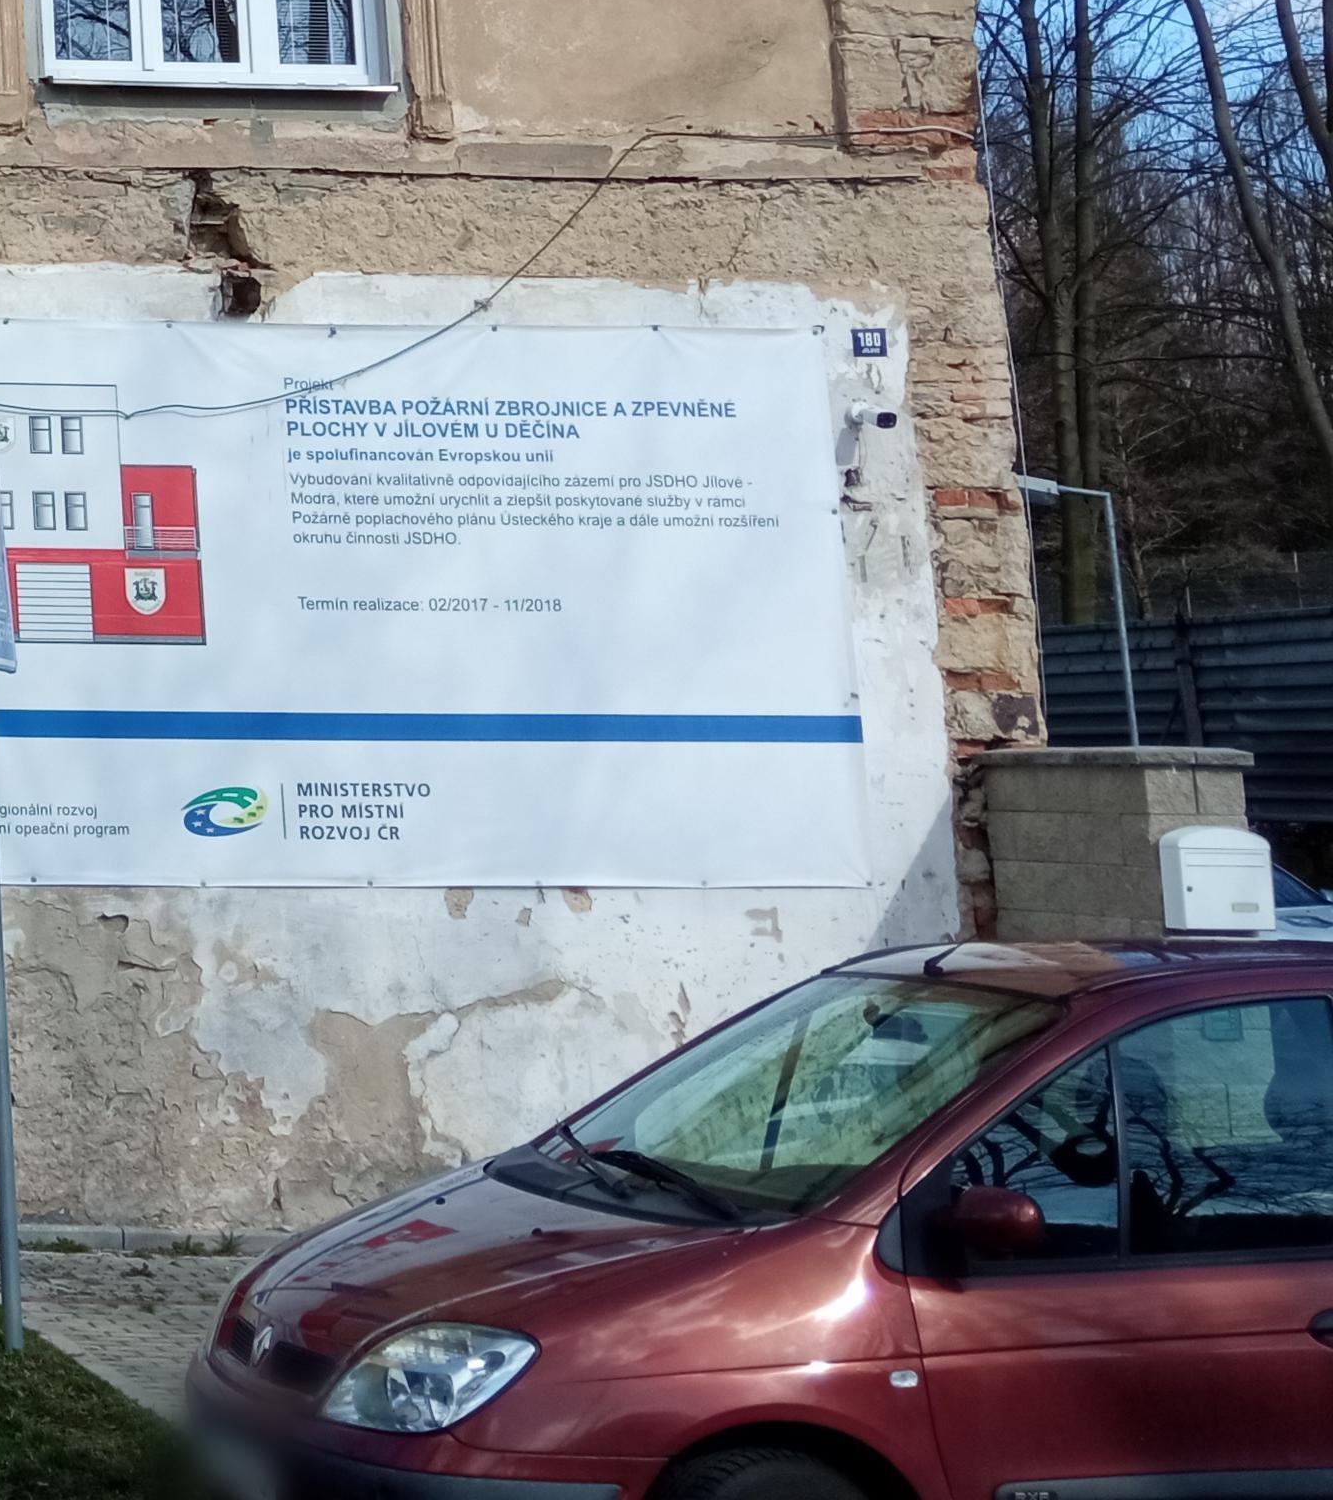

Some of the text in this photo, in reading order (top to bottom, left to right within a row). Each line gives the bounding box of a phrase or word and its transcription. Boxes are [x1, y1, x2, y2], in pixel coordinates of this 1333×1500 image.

[857, 332, 882, 347] 180
[283, 377, 334, 391] Projekt
[285, 396, 737, 418] PŘÍSTAVBA POŽÁRNÍ ZBROJNICE A ZPEVNĚNÉ
[287, 419, 581, 439] PLOCHY V JÍLOVÉM U DĚČÍNA
[288, 449, 301, 463] je
[306, 448, 434, 463] spolufinancován
[439, 449, 521, 464] Evropskou
[290, 472, 372, 488] Vybudování
[377, 473, 454, 487] kvalitativně
[459, 474, 560, 490] odpovídajícího
[619, 477, 641, 490] pro
[645, 475, 698, 488] JSDHO
[702, 475, 743, 488] Jílové
[384, 493, 435, 506] umožní
[439, 493, 489, 508] urychlit
[494, 496, 502, 506] a
[507, 494, 551, 509] zlepšit
[555, 495, 643, 510] poskytované
[647, 495, 690, 510] služby
[695, 498, 702, 507] v
[355, 512, 453, 527] poplachového
[458, 512, 495, 527] plánu
[501, 510, 574, 526] Ústeckého
[578, 514, 612, 529] kraje
[617, 518, 625, 527] a
[629, 514, 659, 527] dále
[663, 515, 714, 528] umožní
[718, 515, 779, 528] rozšíření
[293, 532, 461, 546] okruhu činnosti JSDHO.
[297, 596, 348, 611] Termín
[353, 597, 423, 612] realizace:
[428, 598, 488, 612] 02/2017
[504, 598, 562, 613] 11/2018
[297, 782, 431, 797] MINISTERSTVO
[57, 805, 98, 819] rozvoj
[298, 802, 404, 819] PRO MÍSTNÍ
[73, 825, 130, 838] program
[299, 823, 400, 840] ROZVOJ ČR
